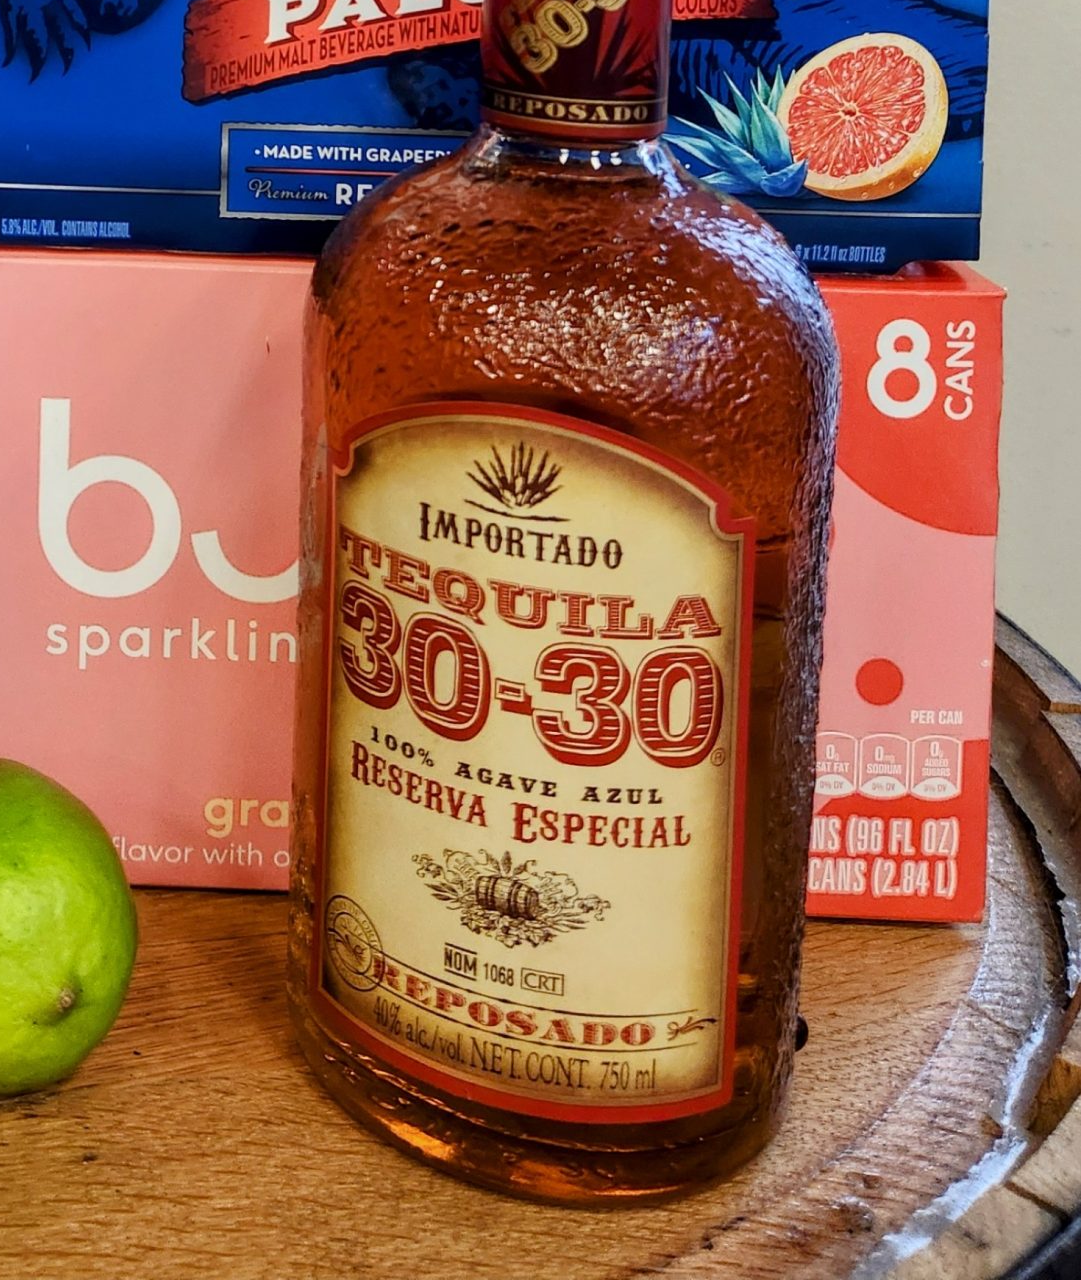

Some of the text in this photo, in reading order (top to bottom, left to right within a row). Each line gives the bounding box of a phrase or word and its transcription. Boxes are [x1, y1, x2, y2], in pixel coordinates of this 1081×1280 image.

[210, 18, 437, 88] PREMIUM MALT BEVERAGE WITH
[493, 92, 649, 121] REPOSADO
[263, 145, 362, 162] MADE WITH
[248, 178, 329, 200] Premium
[2, 218, 98, 237] 5.8% CONTAINS
[811, 245, 886, 263] 11.2 BOTTLES
[867, 318, 976, 420] 8 CANS
[419, 502, 623, 569] IMPORTADO
[340, 524, 722, 640] TEQUILA
[46, 617, 297, 670] sparklin
[340, 581, 723, 770] 30-30
[910, 709, 963, 725] PER CAN
[370, 726, 663, 805] 100% AGAVE AZUL
[867, 763, 902, 775] SODIUM
[351, 740, 691, 849] RESERVA ESPECIAL
[111, 836, 194, 864] flavor
[203, 841, 263, 867] with
[846, 815, 959, 857] (96 FL OZ)
[808, 857, 930, 898] CANS (2.84
[443, 945, 561, 993] NOM 1068 CRT
[372, 953, 656, 1048] REPOSADO
[373, 995, 656, 1091] 40% alc./vol. CONT. 750 ml
